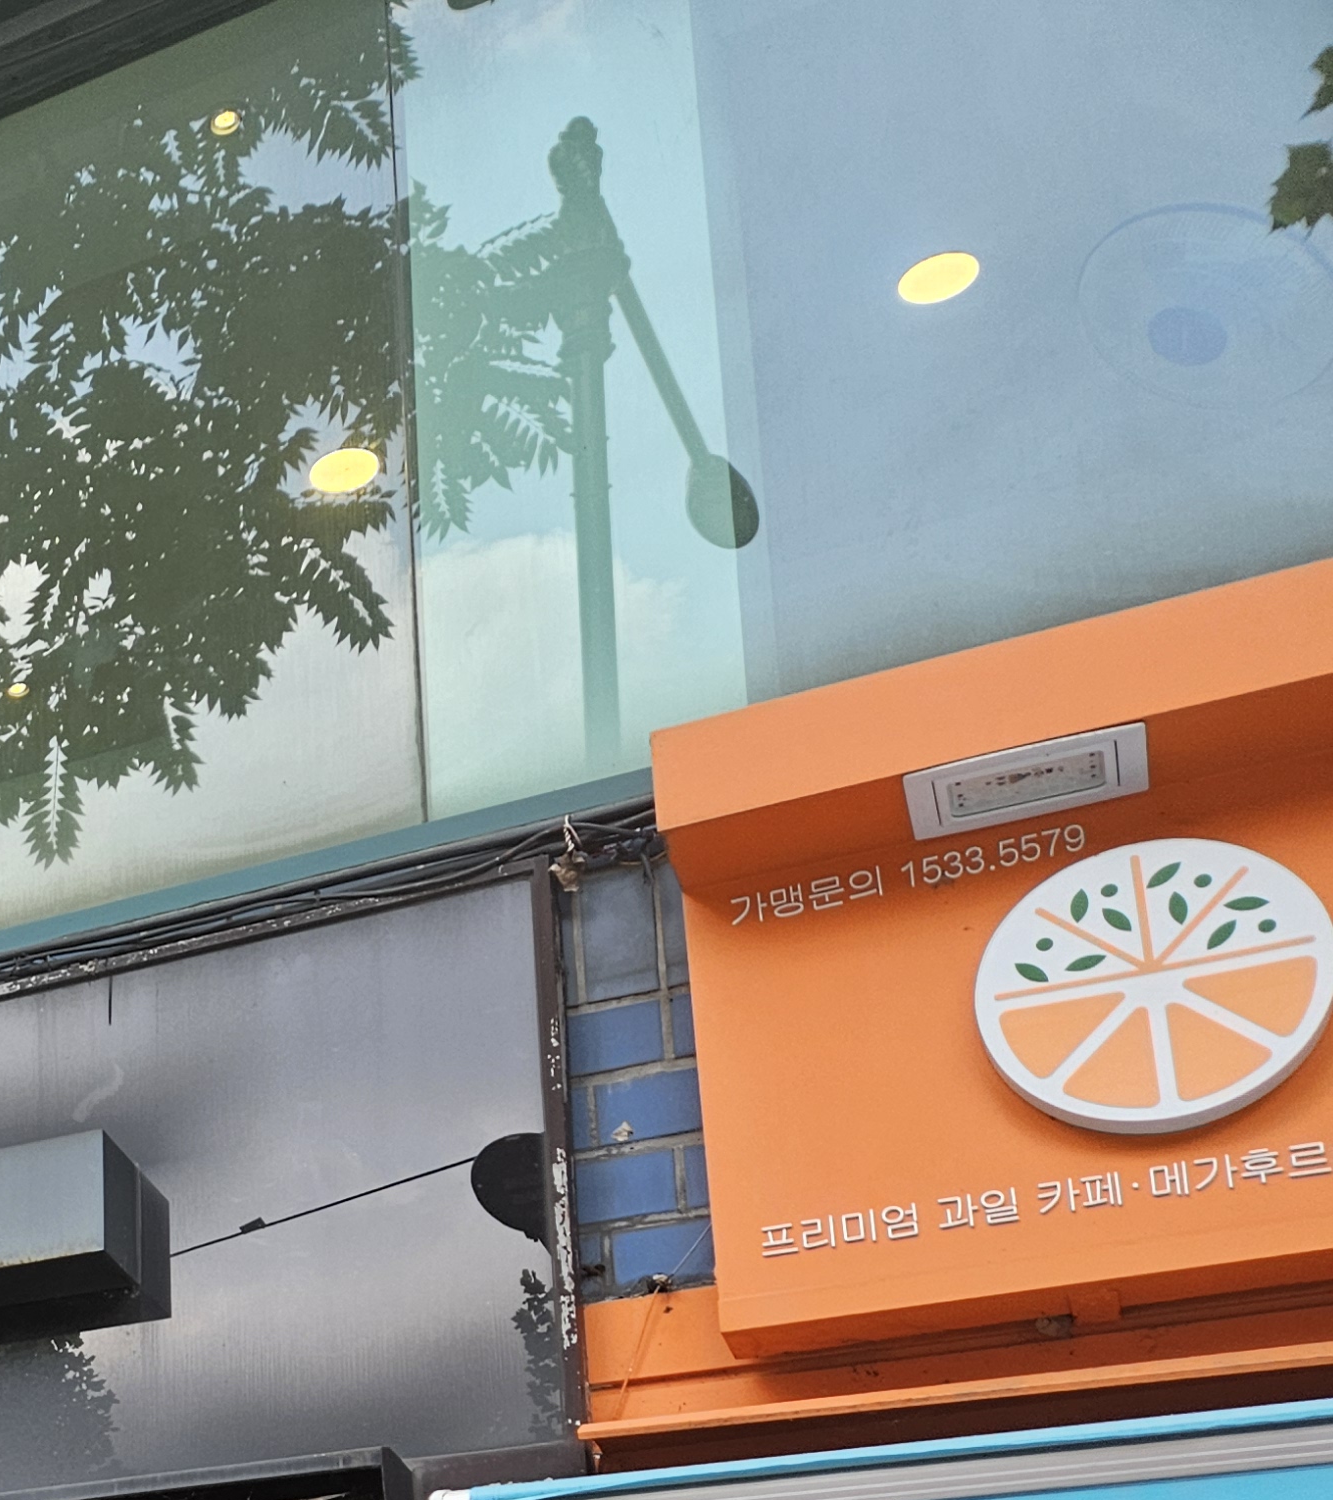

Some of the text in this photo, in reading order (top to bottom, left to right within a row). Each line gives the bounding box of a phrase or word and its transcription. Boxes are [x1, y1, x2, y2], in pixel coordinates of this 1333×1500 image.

[730, 823, 1085, 927] 가맹문의 1533.5579
[761, 1202, 920, 1258] 프리미엄
[936, 1186, 1021, 1231] 과일
